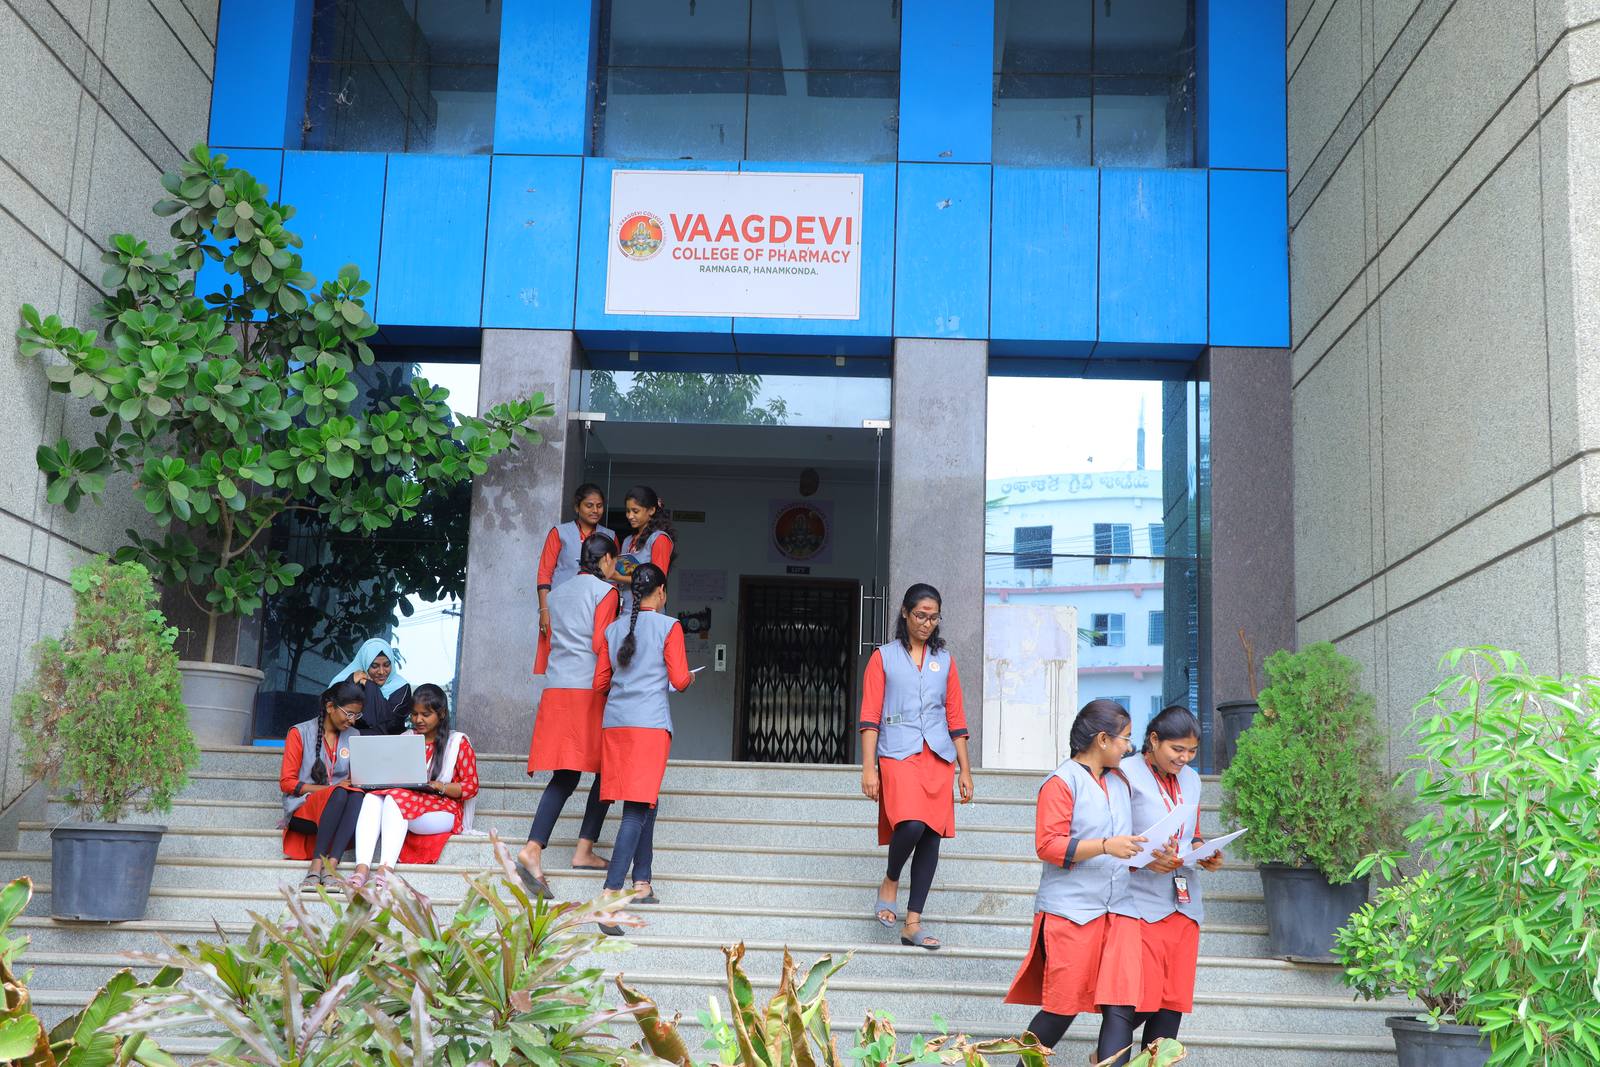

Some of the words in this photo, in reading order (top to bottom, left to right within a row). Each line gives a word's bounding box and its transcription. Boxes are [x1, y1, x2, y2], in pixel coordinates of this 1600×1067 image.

[669, 213, 853, 245] VAAGDEVI
[672, 247, 740, 261] COLLEGE
[743, 248, 764, 261] OF
[768, 249, 851, 264] PHARMACY
[699, 265, 752, 274] RAMNAGAR,
[753, 266, 819, 276] HANAMKONDA.
